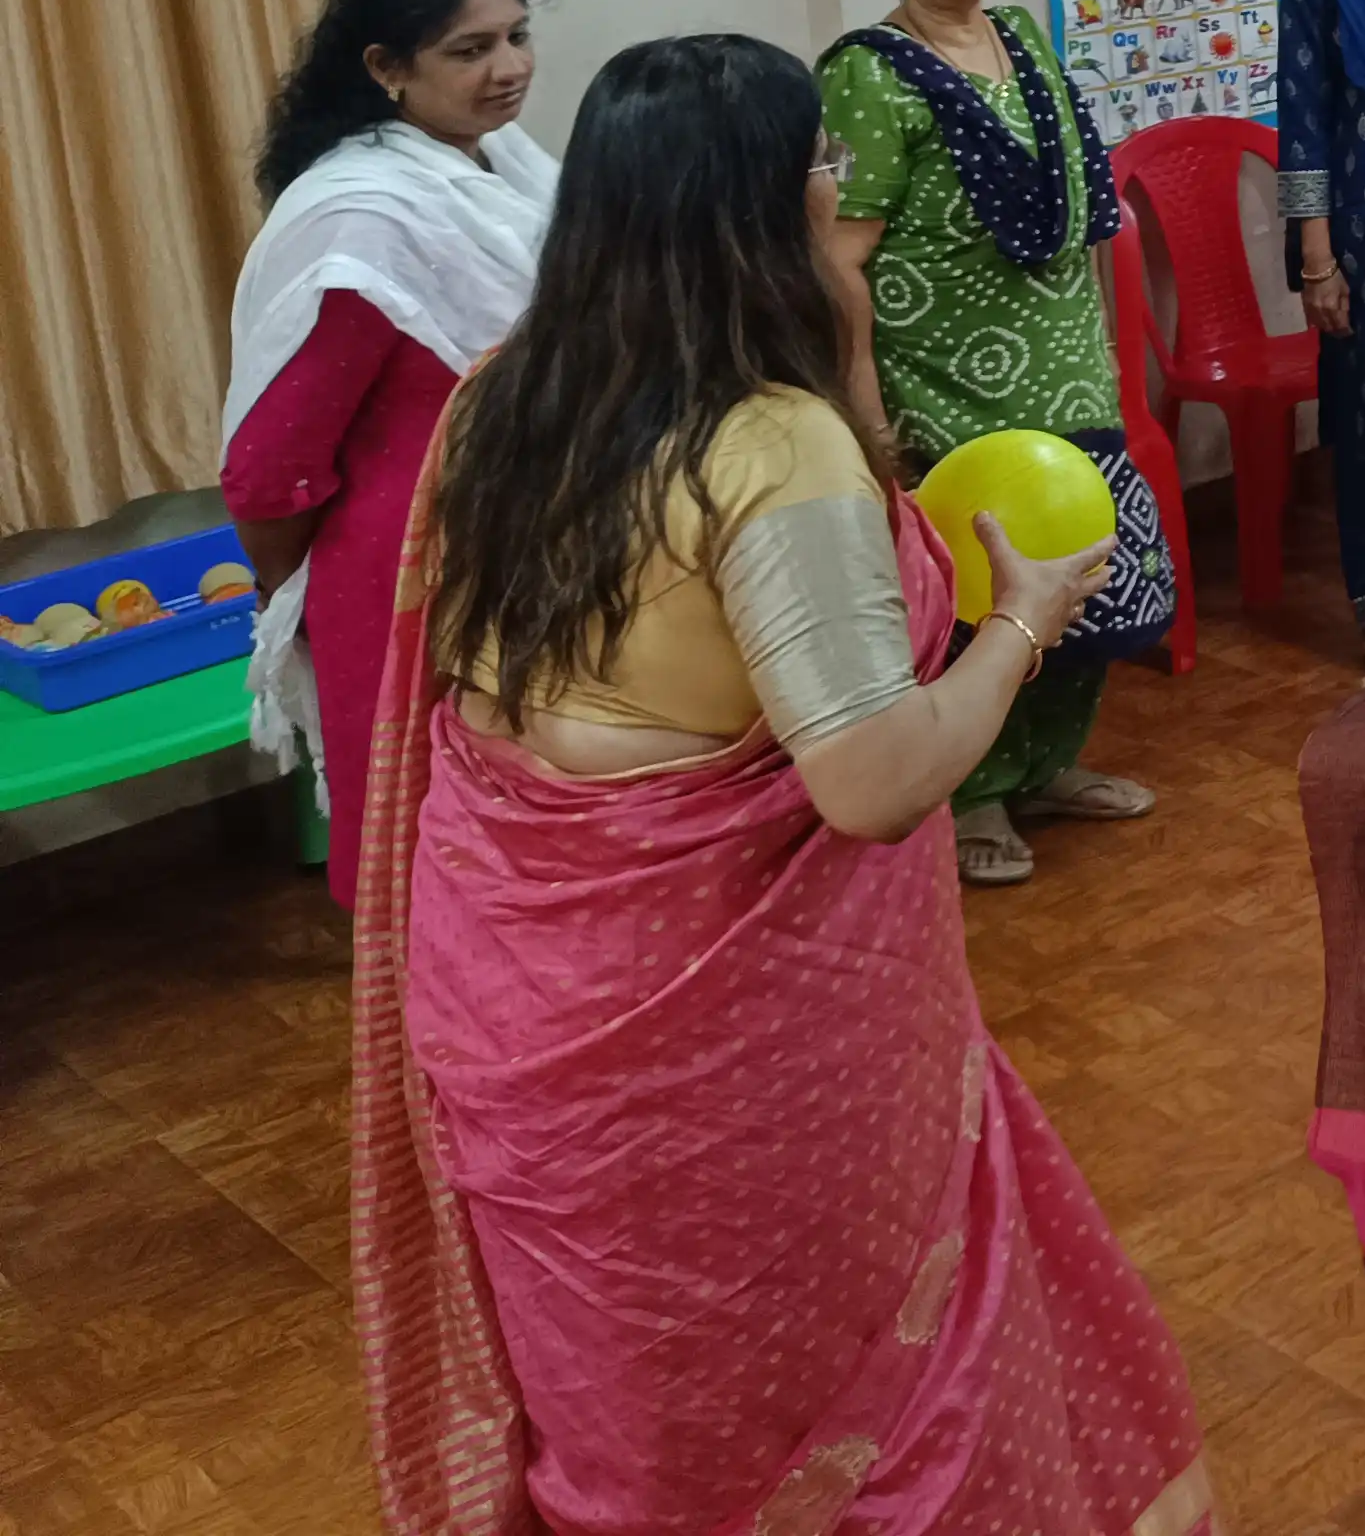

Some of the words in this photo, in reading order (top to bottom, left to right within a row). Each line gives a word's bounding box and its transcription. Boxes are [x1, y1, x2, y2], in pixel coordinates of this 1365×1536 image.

[1198, 18, 1221, 32] Ss
[1240, 10, 1260, 25] Tt
[1113, 32, 1138, 48] Qq
[1156, 25, 1177, 40] Rr
[1068, 40, 1092, 56] Pp
[1217, 69, 1239, 86] Yy
[1250, 63, 1269, 78] Zz
[1145, 81, 1177, 98] Ww
[1181, 75, 1205, 92] Xx
[1109, 89, 1133, 104] Vv
